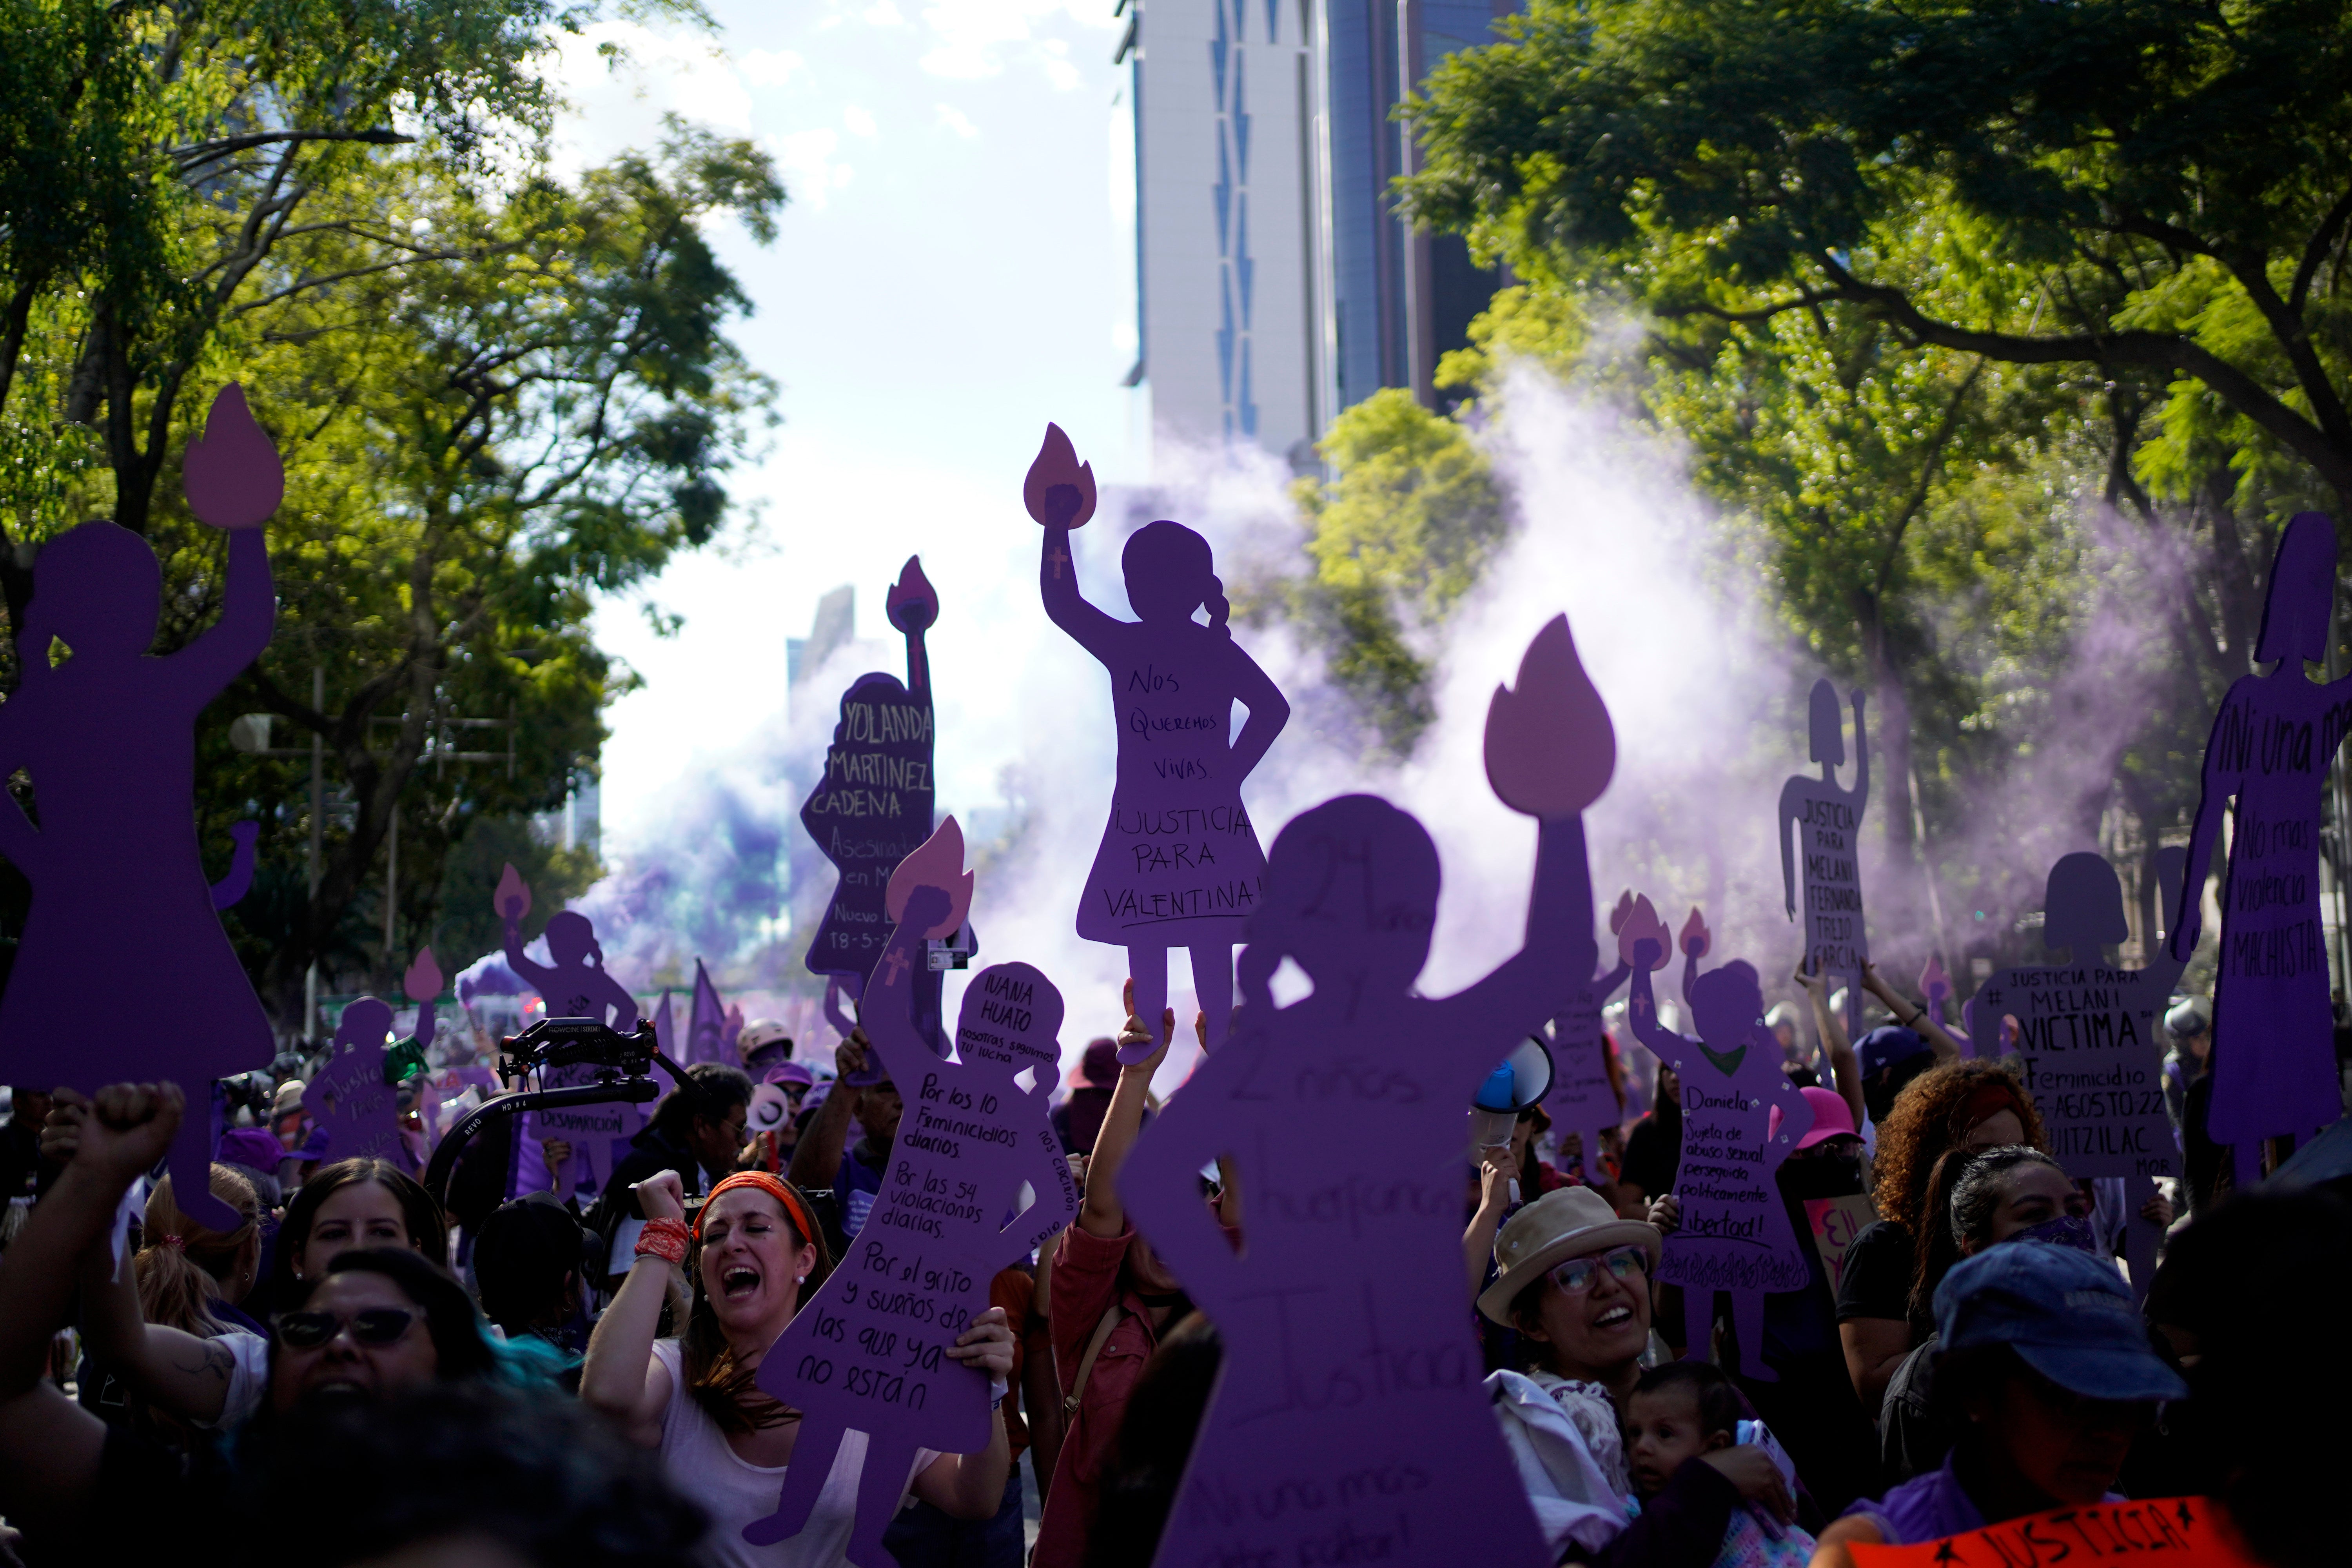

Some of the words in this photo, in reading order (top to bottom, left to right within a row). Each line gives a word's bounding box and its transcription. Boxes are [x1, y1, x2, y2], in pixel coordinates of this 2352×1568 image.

[845, 702, 933, 744] YOLANDA
[829, 751, 931, 791] MARTINEZ
[811, 789, 901, 817] CADENA
[1804, 798, 1855, 830] JUSTICIA
[1816, 830, 1844, 851] PARA
[2242, 811, 2266, 860] No
[1132, 842, 1215, 873] PARA
[1808, 853, 1853, 882] MELANI
[846, 871, 868, 887] en
[835, 902, 878, 923] Nuevo
[1104, 877, 1262, 918] VALENTINA!
[2232, 918, 2318, 978] MACHISTA
[984, 974, 1033, 1006] IVANA
[2011, 971, 2087, 987] JUSTICIA
[2095, 968, 2140, 984] PARA
[2031, 988, 2120, 1013] MELANI
[2020, 1011, 2138, 1051] VICTIMA
[978, 1046, 1011, 1064] lucha
[1009, 1041, 1054, 1063] seguimos
[2024, 1058, 2145, 1090] Feminicidio
[920, 1073, 946, 1102] Por
[948, 1087, 972, 1109] los
[1687, 1086, 1749, 1111] Daniela
[502, 1103, 512, 1112] HD
[464, 1118, 482, 1136] REVO
[917, 1105, 1018, 1148] Feminicidios
[1686, 1119, 1722, 1142] Sujeta
[1726, 1126, 1742, 1141] de
[1686, 1143, 1723, 1159] abuso
[2137, 1158, 2171, 1176] MOR
[895, 1162, 915, 1187] Por
[924, 1168, 947, 1196] las
[955, 1181, 976, 1202] 54
[1038, 1131, 1056, 1152] nos
[1053, 1158, 1074, 1211] crecieron
[1684, 1163, 1749, 1183] perseguida
[891, 1190, 982, 1223] violaciones
[882, 1207, 944, 1239] diarias.
[1030, 1221, 1060, 1249] alas
[864, 1241, 898, 1275] Por
[899, 1256, 922, 1283] el
[842, 1281, 858, 1304] y
[867, 1290, 934, 1323] sueños
[940, 1304, 967, 1333] de
[813, 1307, 845, 1343] las
[858, 1326, 897, 1357] que
[904, 1338, 941, 1373] ya
[797, 1355, 832, 1383] no
[843, 1366, 926, 1410] están
